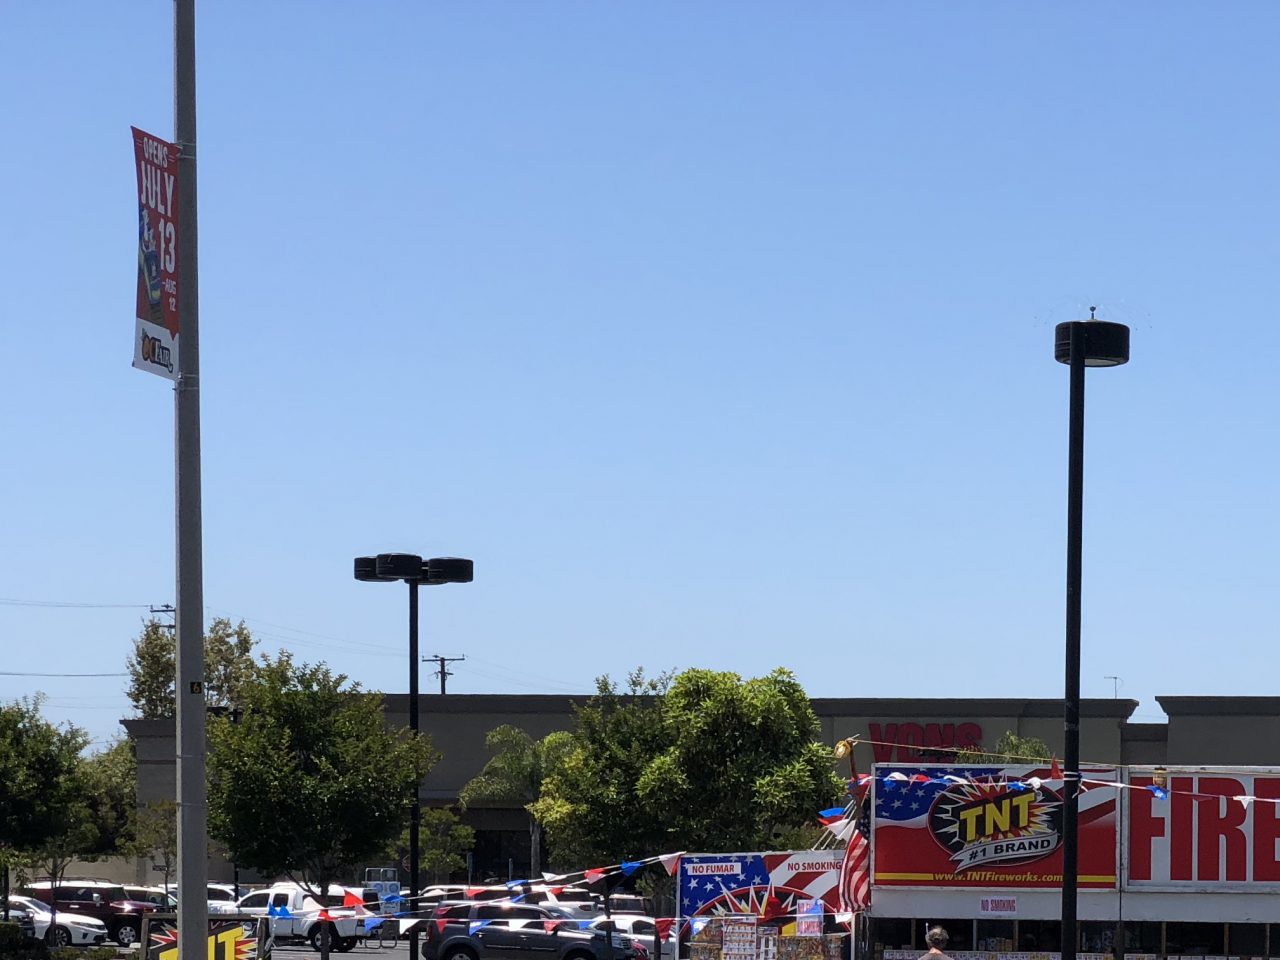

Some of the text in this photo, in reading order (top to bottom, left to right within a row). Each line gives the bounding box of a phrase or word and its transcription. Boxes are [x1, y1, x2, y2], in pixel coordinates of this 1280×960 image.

[143, 137, 168, 168] OPENS
[141, 160, 174, 218] JULY
[159, 218, 176, 274] 13
[169, 299, 176, 312] 12
[868, 722, 983, 763] VONS
[959, 792, 1036, 842] TNT
[969, 839, 1051, 860] #1 BRAND
[692, 864, 735, 873] NO FUMAR
[788, 861, 842, 871] NO SMOKING
[934, 871, 1063, 883] www.TNTFireworks.com
[981, 899, 1015, 911] NO SMOKING
